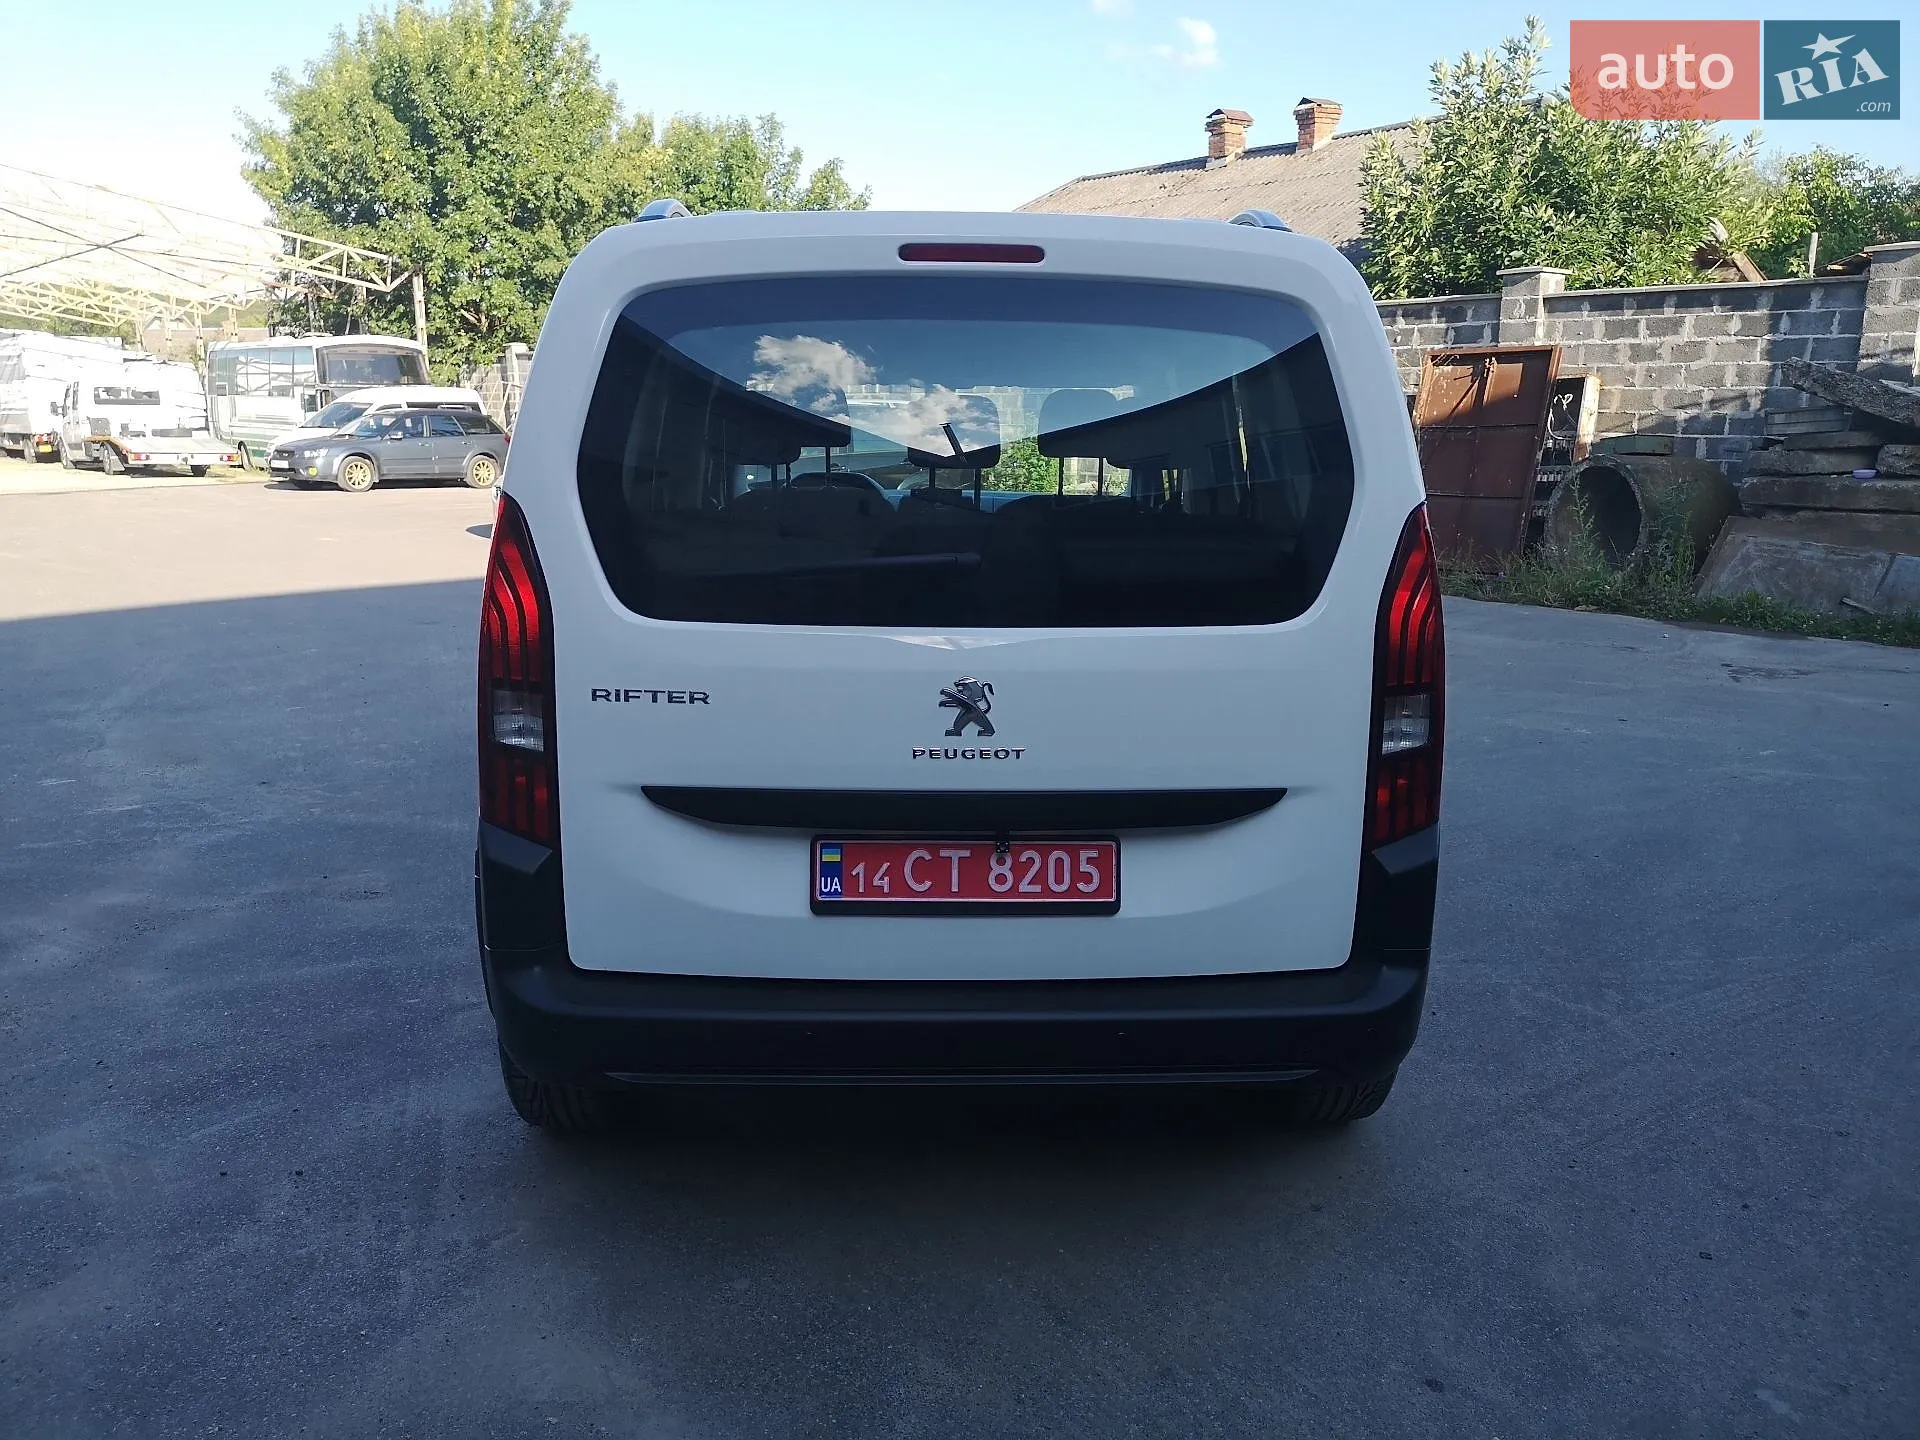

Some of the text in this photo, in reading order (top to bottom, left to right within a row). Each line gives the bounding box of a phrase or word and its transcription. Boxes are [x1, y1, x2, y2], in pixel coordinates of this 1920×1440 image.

[591, 688, 711, 704] RIFTER
[912, 747, 1026, 760] PEUGEOT
[850, 849, 1101, 893] 14 CT 8205
[820, 876, 842, 893] UA
